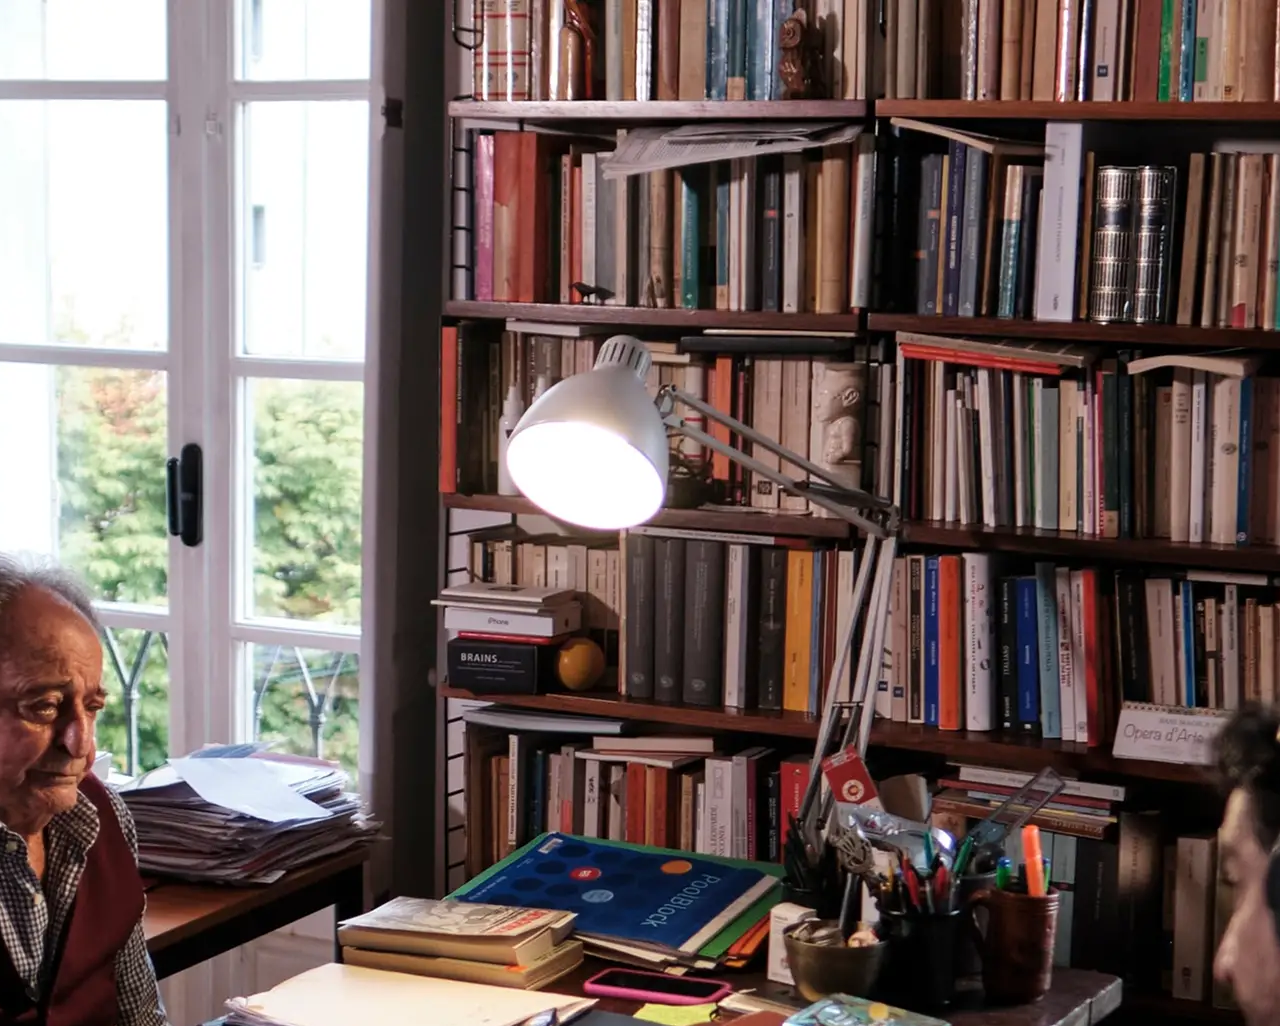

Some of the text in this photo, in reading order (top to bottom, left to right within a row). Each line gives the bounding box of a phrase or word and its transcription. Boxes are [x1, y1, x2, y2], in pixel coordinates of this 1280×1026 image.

[487, 617, 509, 626] iPhone
[460, 652, 498, 663] BRAINS
[1123, 723, 1161, 743] Opera
[640, 873, 721, 928] PoolBlock
